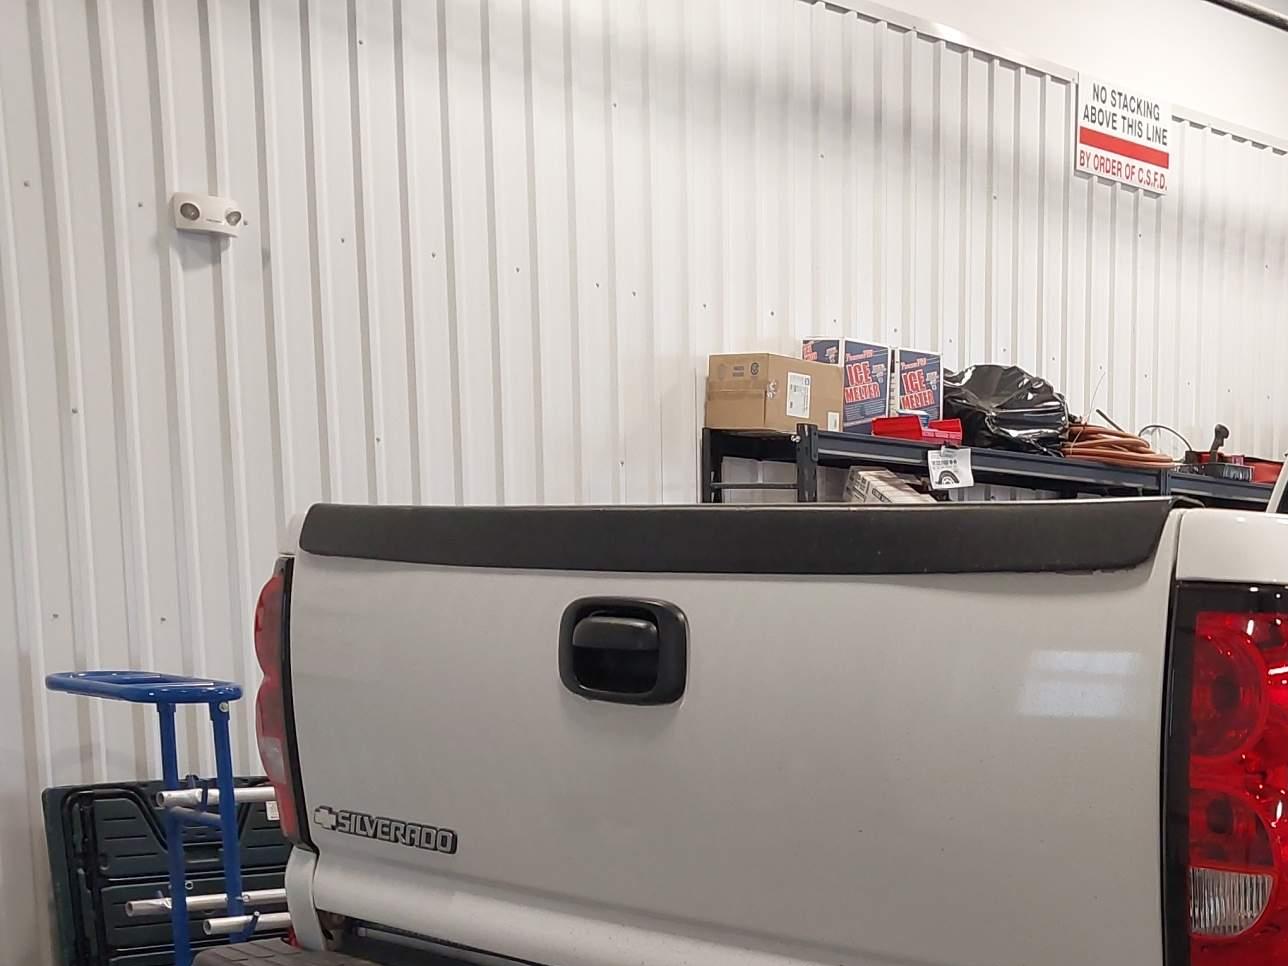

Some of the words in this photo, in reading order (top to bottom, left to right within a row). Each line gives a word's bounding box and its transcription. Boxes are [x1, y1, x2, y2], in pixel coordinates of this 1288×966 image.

[1092, 82, 1107, 104] NO
[1110, 89, 1160, 121] STACKING
[1082, 104, 1118, 130] ABOVE
[1121, 115, 1143, 138] THIS
[1146, 125, 1168, 146] LINE
[1079, 150, 1092, 168] BY
[1093, 154, 1122, 178] ORDER
[1125, 163, 1136, 180] OF
[1138, 168, 1168, 190] C.S.F.D.
[846, 361, 873, 387] ICE
[901, 369, 927, 394] ICE
[844, 381, 880, 403] MELTER
[900, 388, 935, 410] MELTER
[337, 809, 458, 855] SILVERADO
